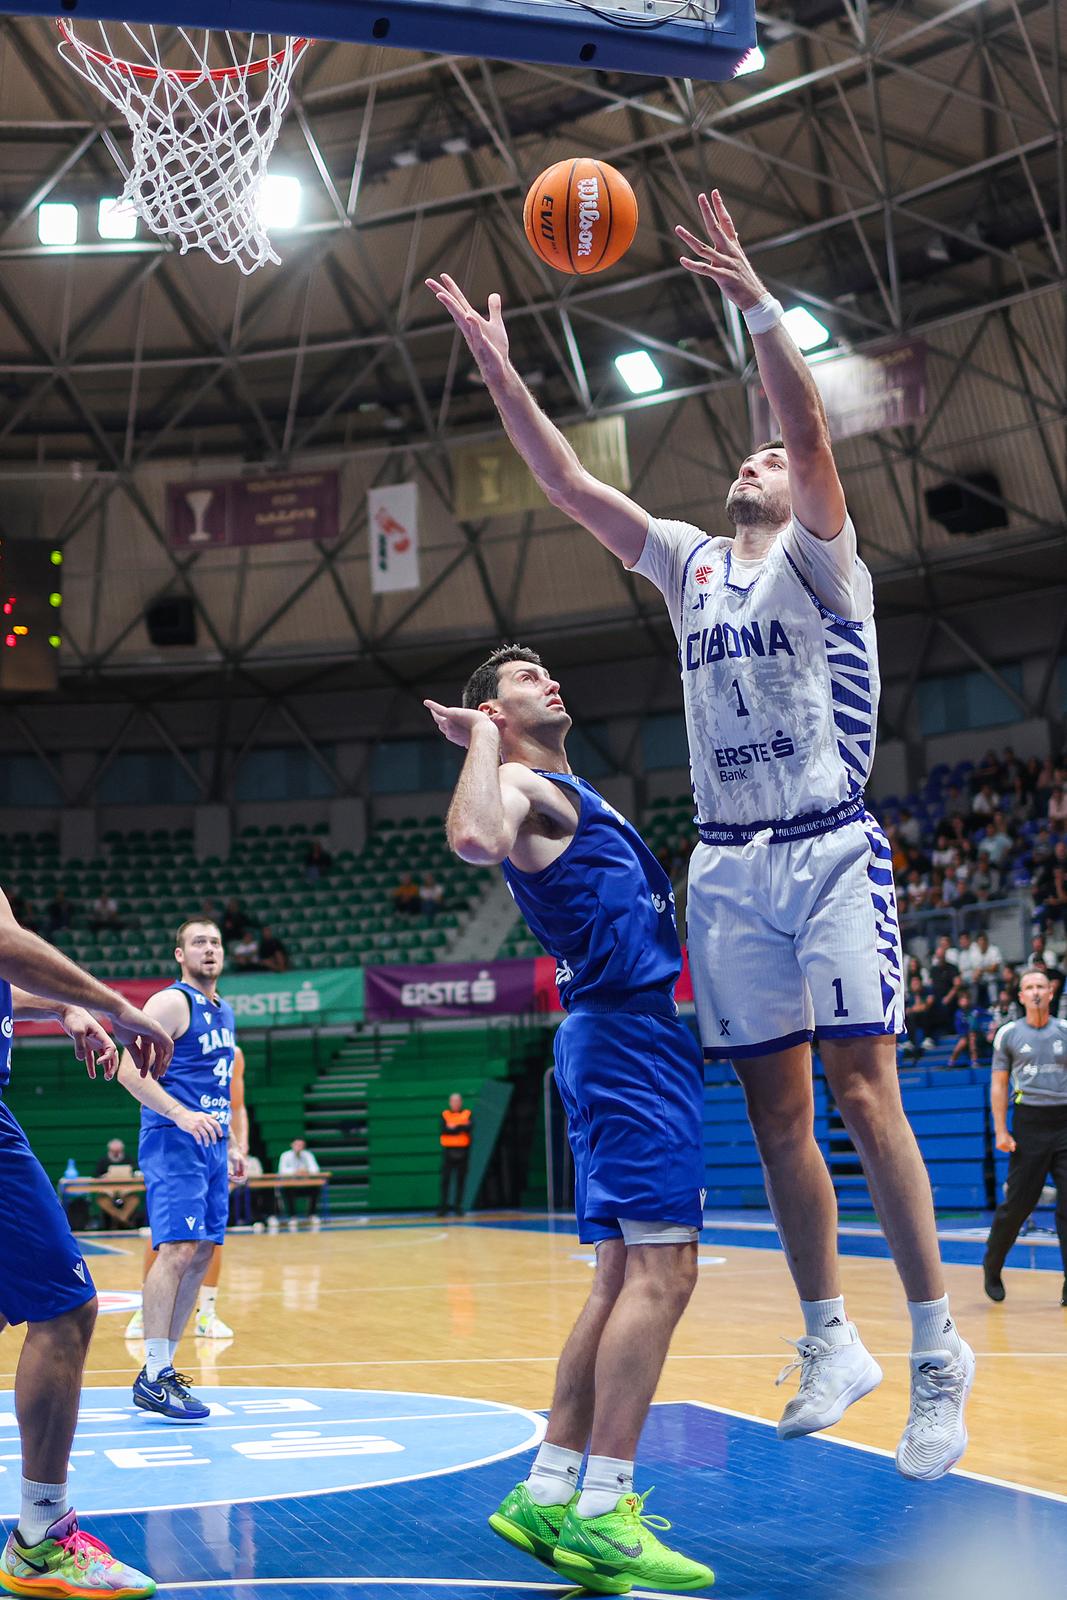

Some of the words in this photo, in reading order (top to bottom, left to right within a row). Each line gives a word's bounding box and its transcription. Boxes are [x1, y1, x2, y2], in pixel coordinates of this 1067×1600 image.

[541, 194, 555, 241] EVO
[577, 177, 600, 256] Wilson
[686, 620, 795, 671] CIBONA
[731, 679, 750, 718] 1
[715, 743, 770, 768] ERSTE
[720, 769, 747, 782] Bank
[401, 981, 469, 1006] ERSTE
[832, 978, 849, 1017] 1
